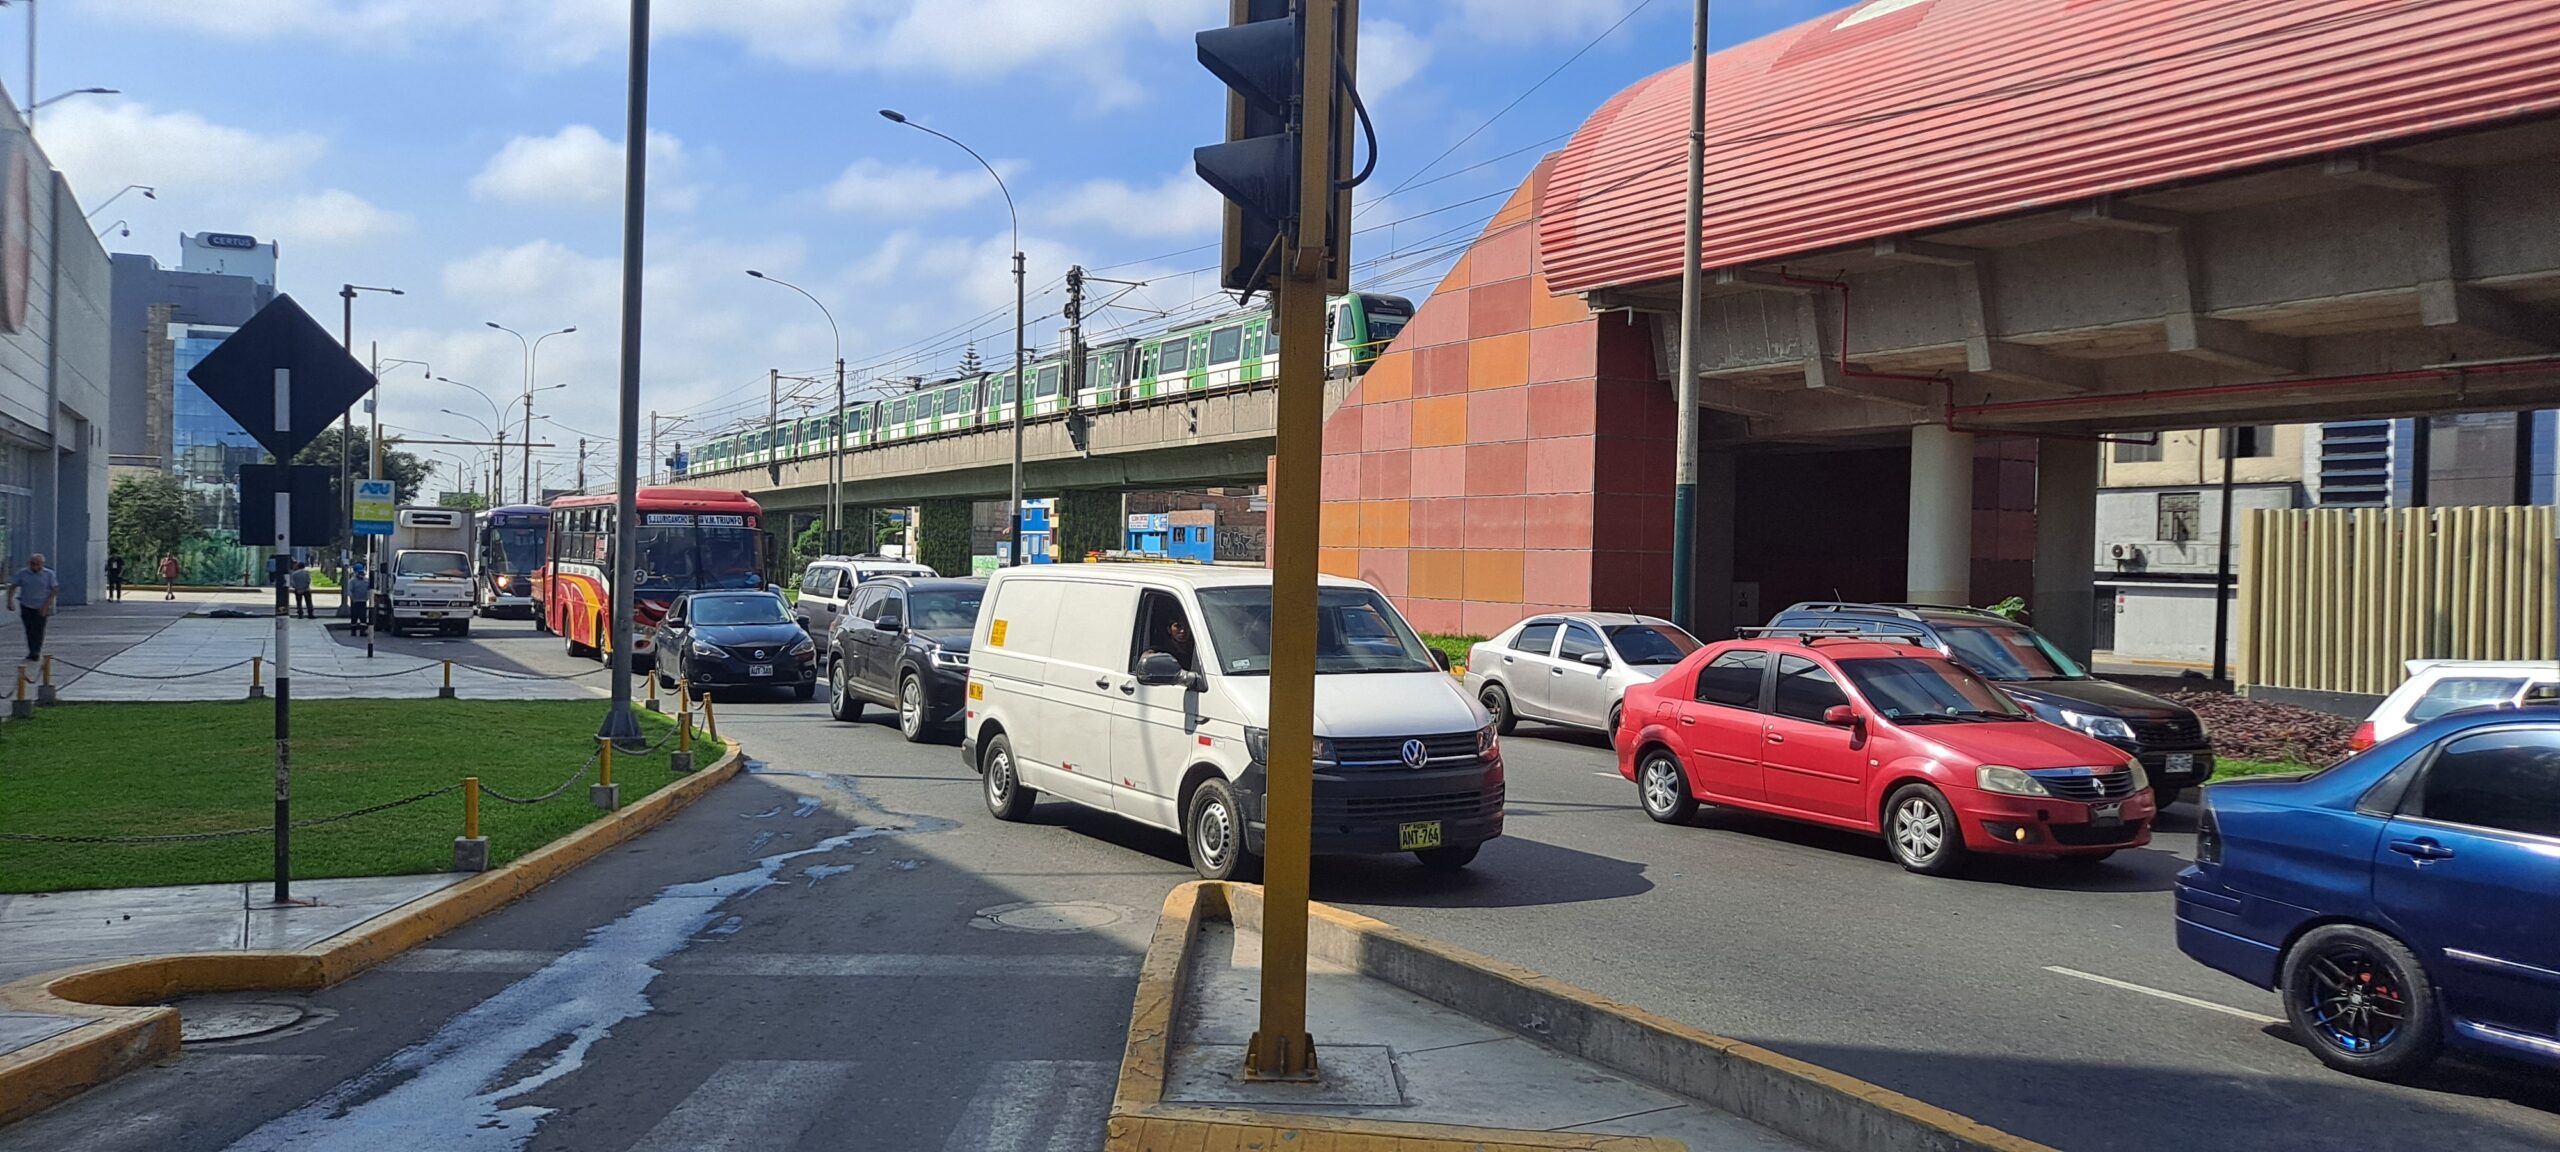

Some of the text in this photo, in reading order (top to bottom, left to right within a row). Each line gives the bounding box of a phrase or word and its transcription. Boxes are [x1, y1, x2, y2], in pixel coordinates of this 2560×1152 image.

[213, 237, 251, 247] CERTUS
[359, 482, 391, 495] ATU
[1402, 827, 1438, 846] ANT-764
